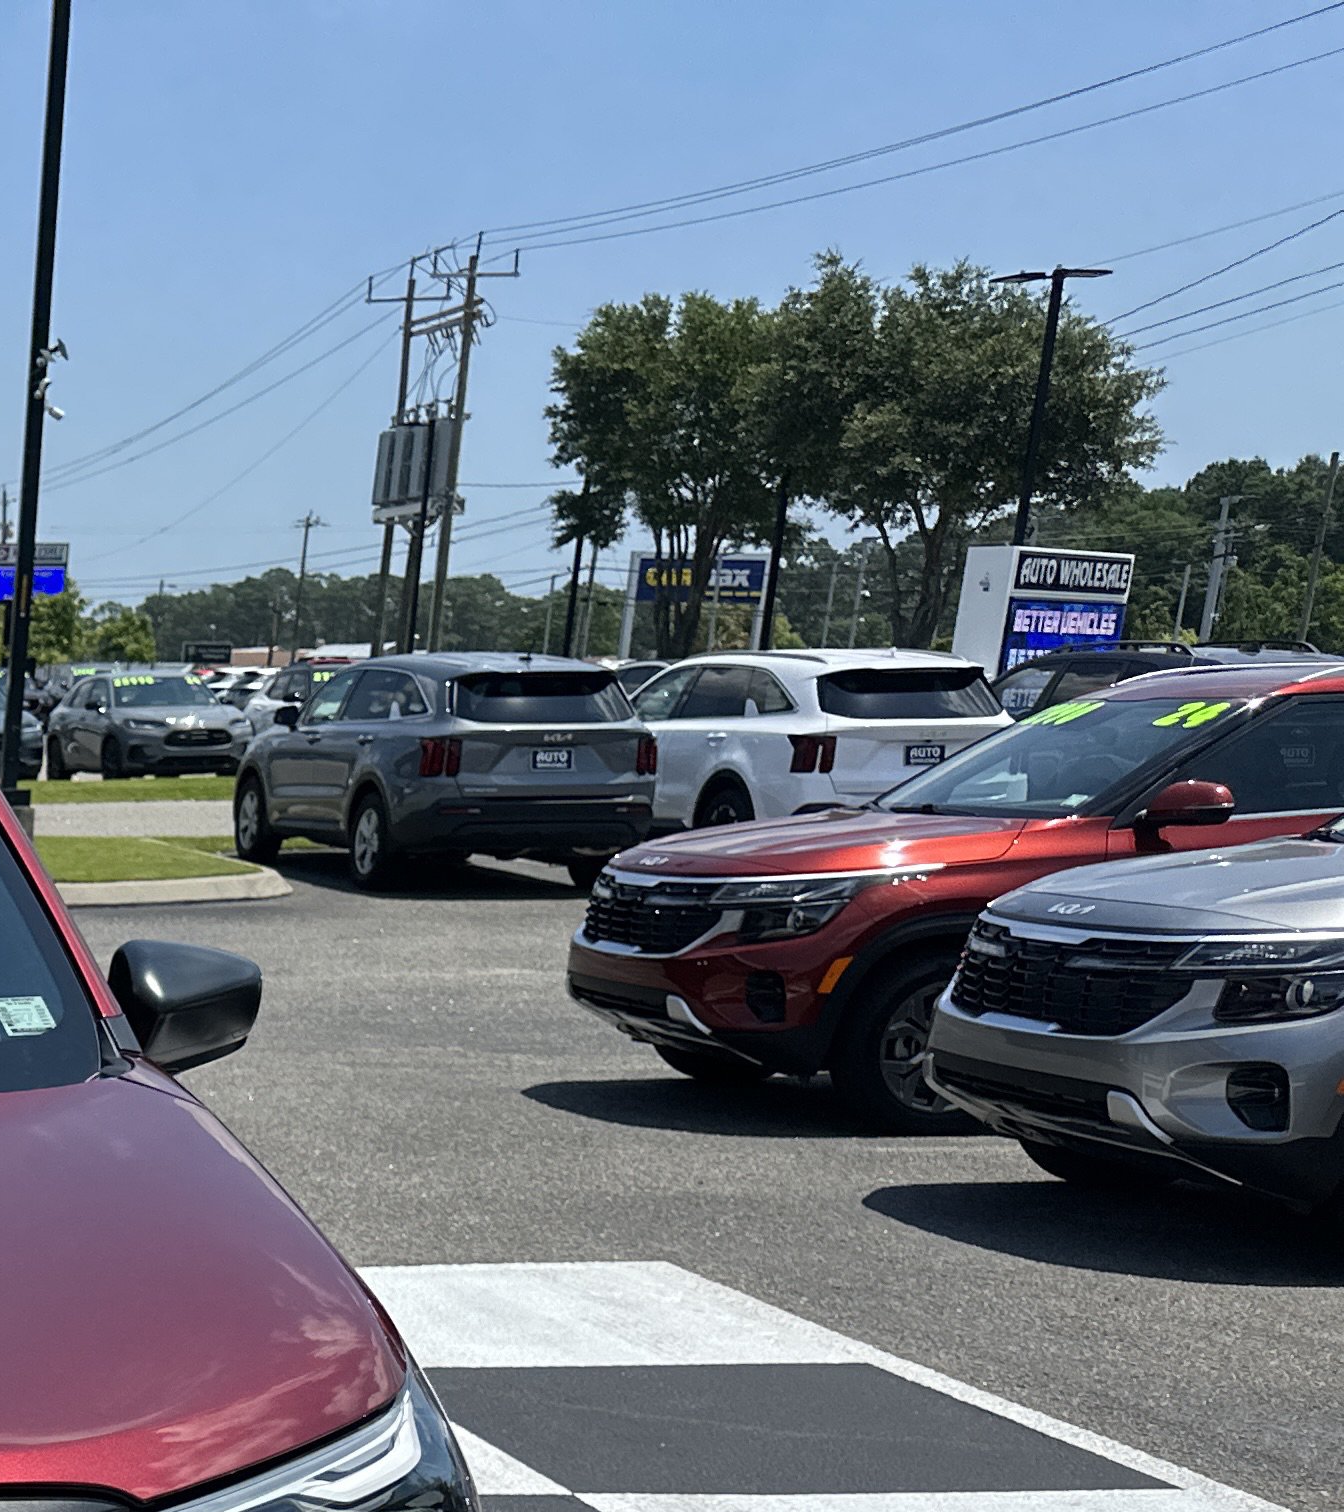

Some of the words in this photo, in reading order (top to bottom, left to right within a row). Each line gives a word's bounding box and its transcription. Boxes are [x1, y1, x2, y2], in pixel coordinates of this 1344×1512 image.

[1020, 557, 1058, 585] AUTO
[1060, 559, 1130, 590] WHOLESALE
[1013, 609, 1060, 634] BETTER
[1060, 611, 1117, 635] VEHICLES
[536, 751, 568, 762] AUTO
[910, 747, 940, 757] AUTO
